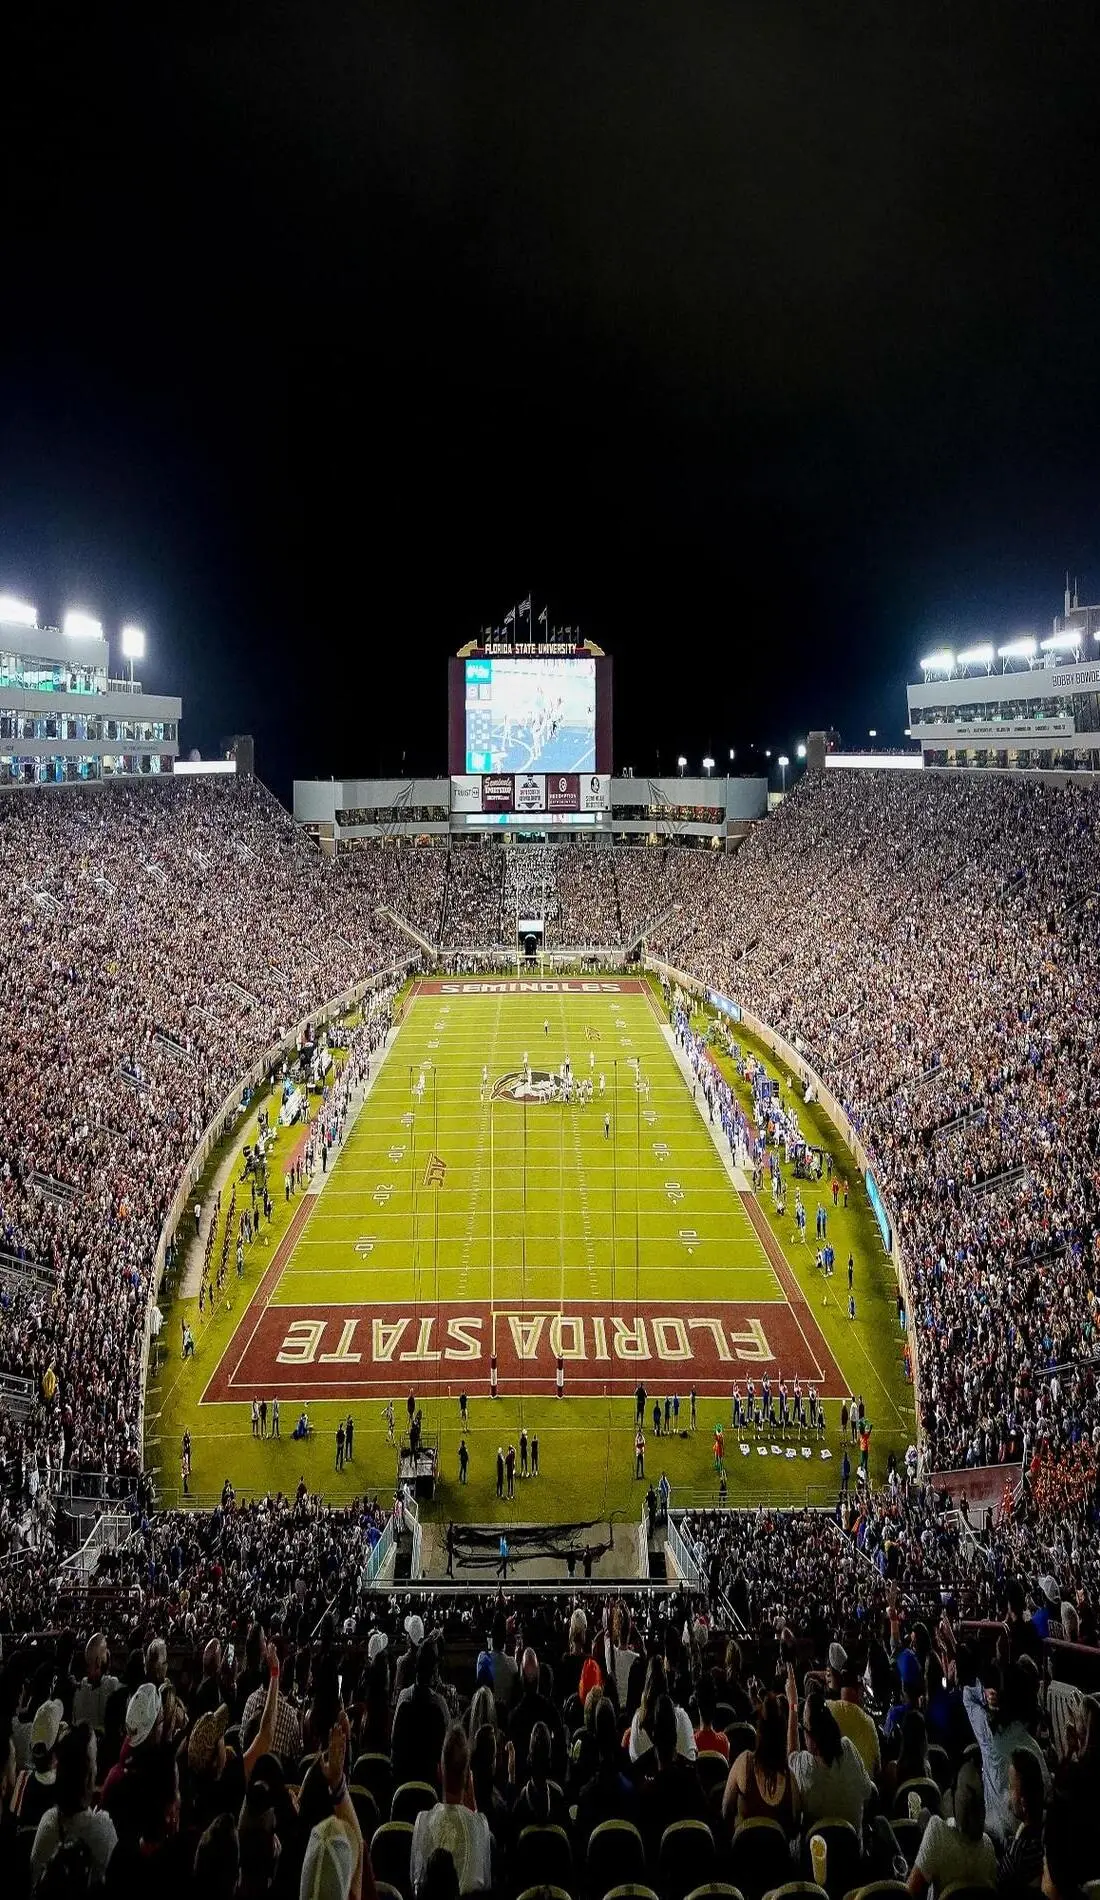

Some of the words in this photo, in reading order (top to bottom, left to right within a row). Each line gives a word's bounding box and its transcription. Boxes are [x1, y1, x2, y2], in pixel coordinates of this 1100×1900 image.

[485, 643, 512, 654] FLORIDA
[515, 643, 536, 654] STATE
[538, 643, 576, 654] UNIVERSITY
[1052, 674, 1074, 687] BOBBY
[439, 982, 621, 993] SEMINOLES
[372, 1184, 394, 1200] 20
[664, 1182, 685, 1199] 20
[354, 1235, 377, 1251] 10
[679, 1229, 701, 1245] 10
[275, 1316, 485, 1363] STATE
[508, 1315, 777, 1362] FLORIDA
